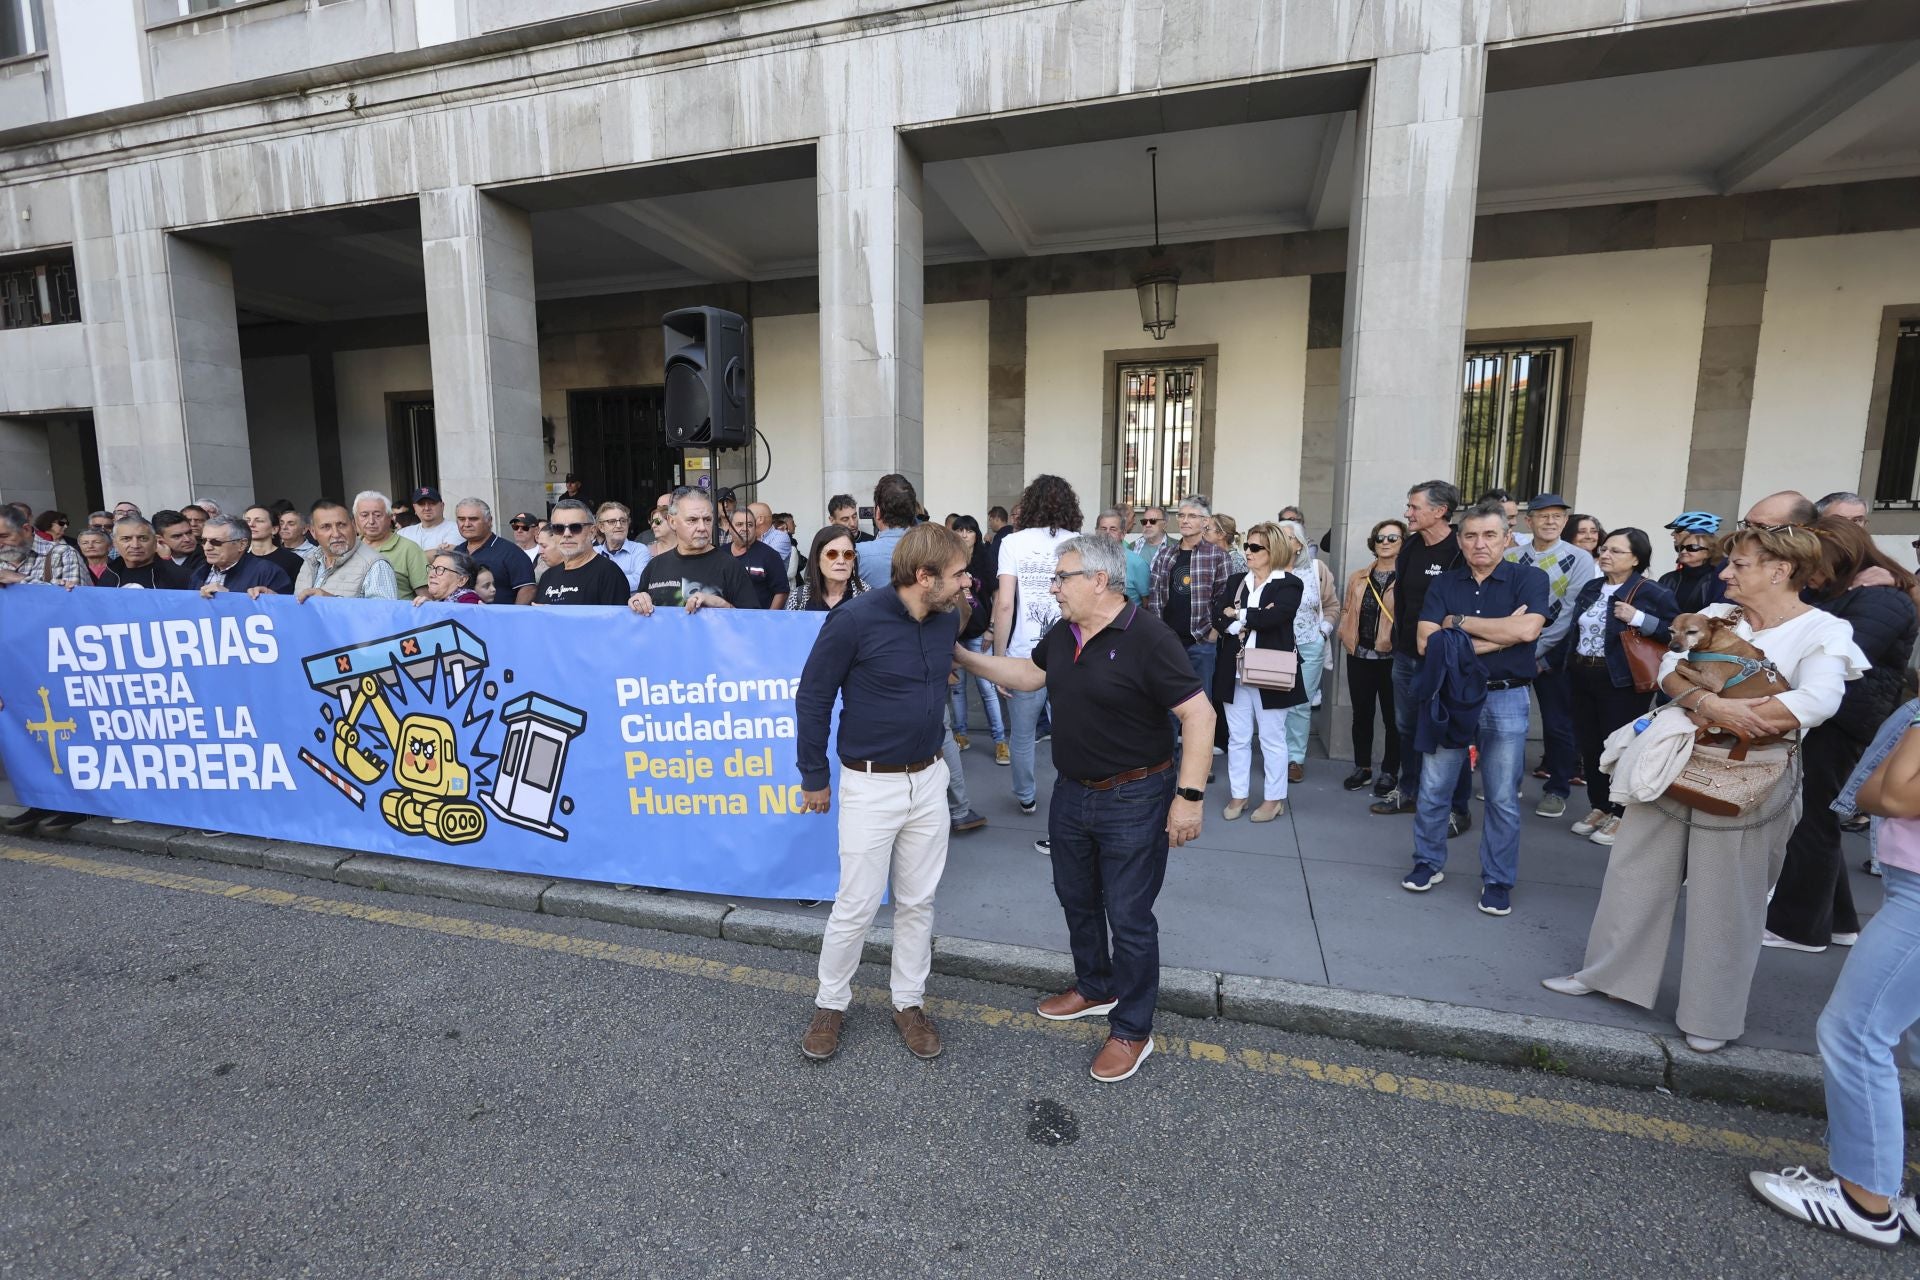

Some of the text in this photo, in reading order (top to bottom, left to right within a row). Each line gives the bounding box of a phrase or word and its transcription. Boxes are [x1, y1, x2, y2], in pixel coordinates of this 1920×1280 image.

[548, 458, 558, 474] 6
[48, 614, 279, 673] ASTURIAS
[63, 671, 195, 707] ENTERA
[88, 705, 258, 741] ROMPE LA
[620, 710, 796, 744] Ciudadana
[67, 743, 297, 791] BARRERA
[624, 746, 773, 785] Peaje del
[628, 786, 748, 815] Huerna
